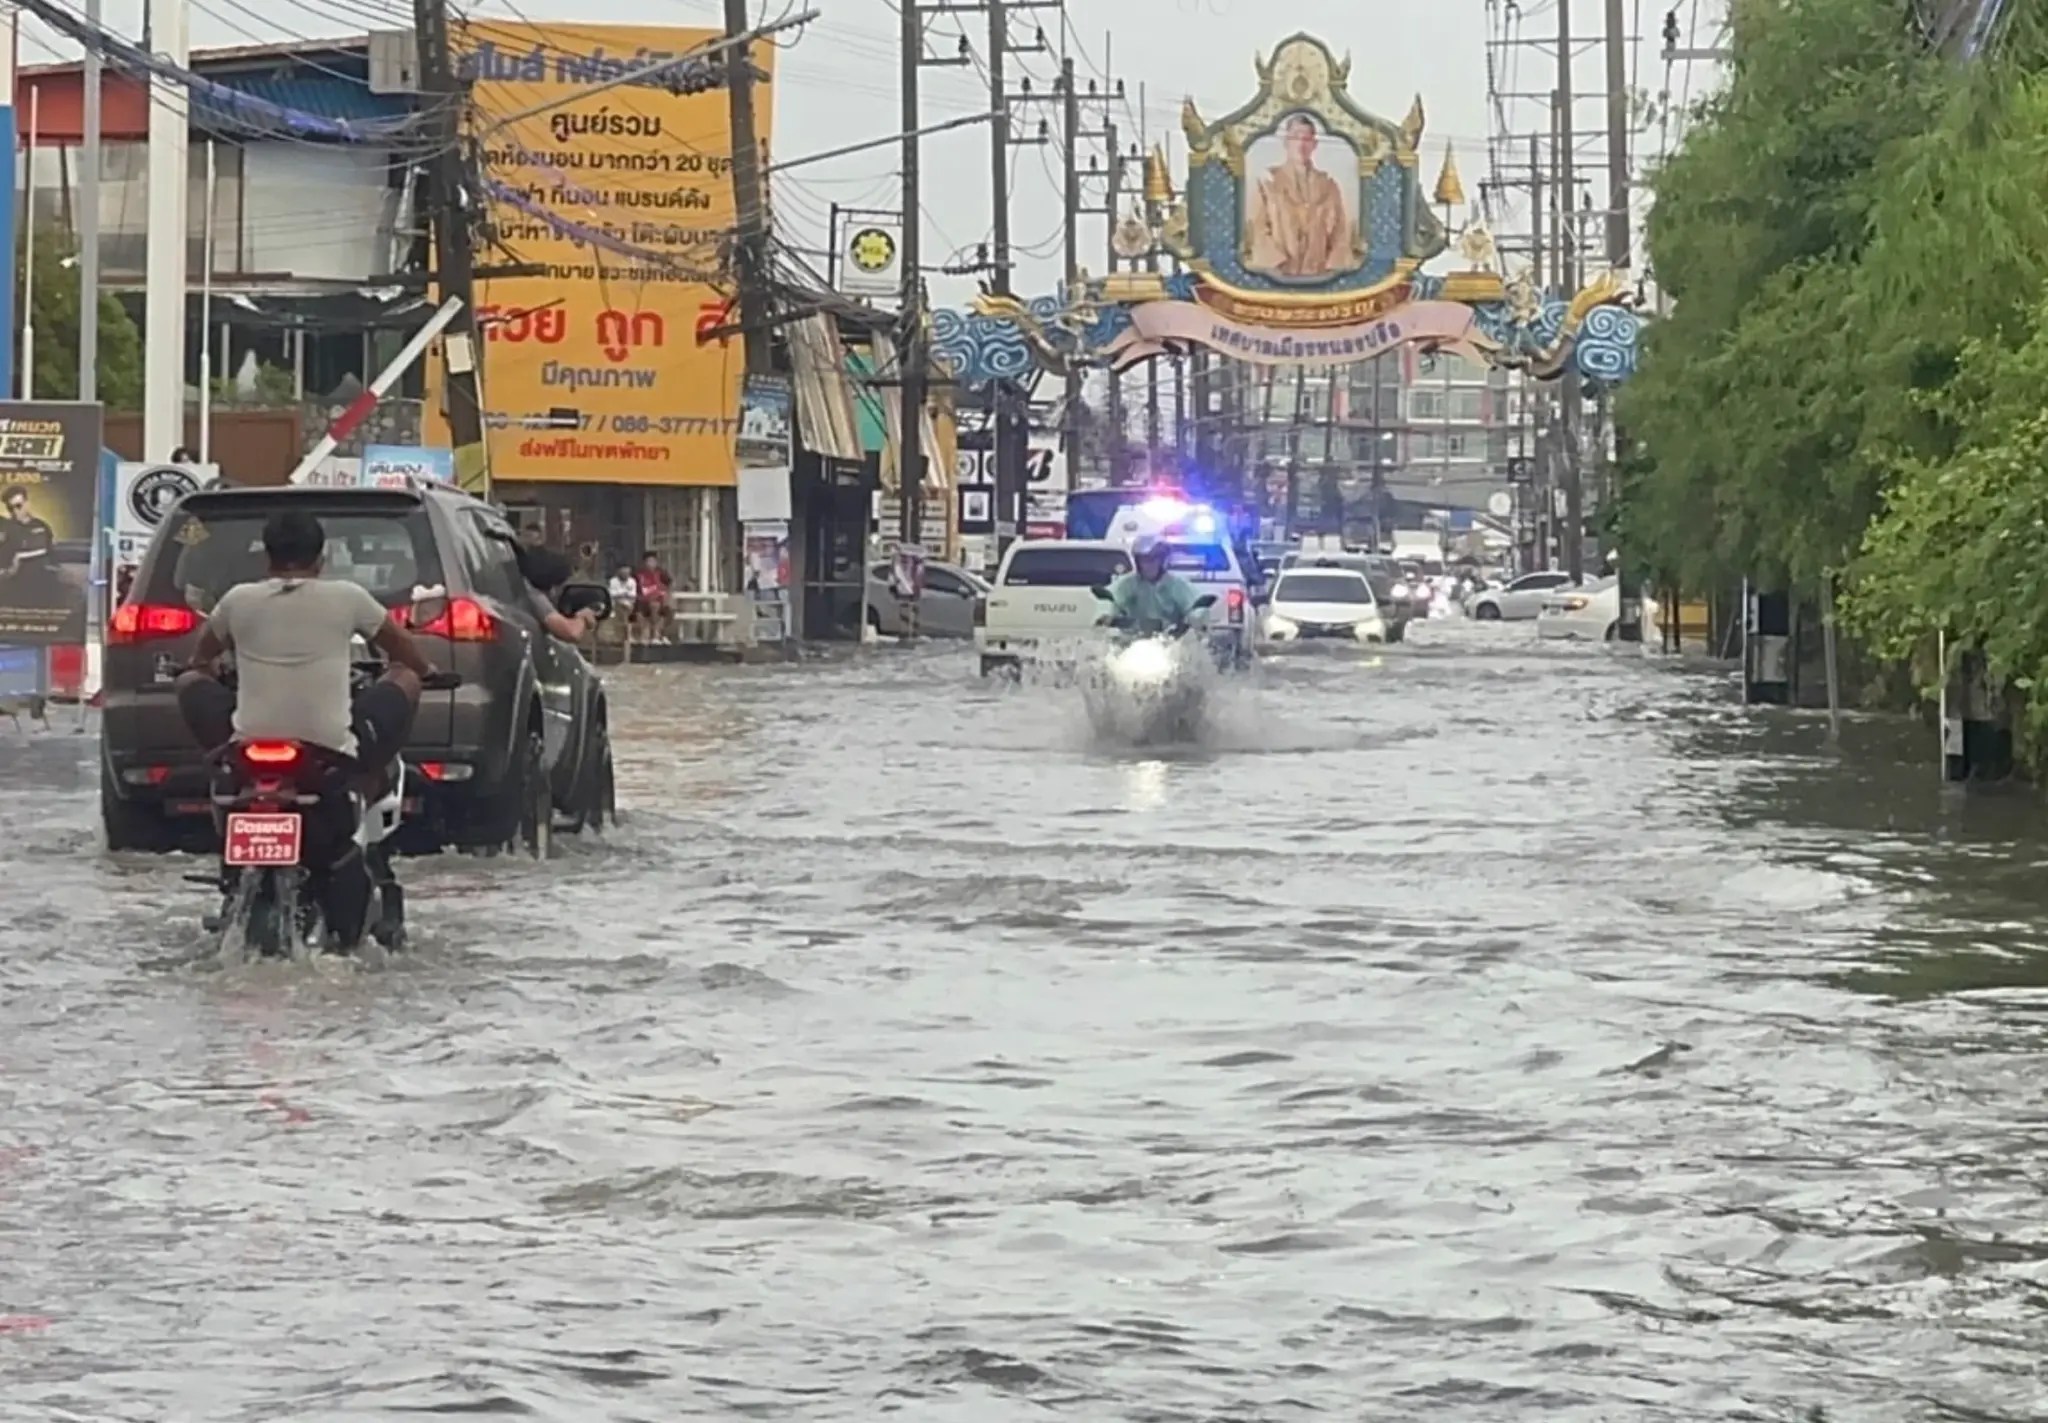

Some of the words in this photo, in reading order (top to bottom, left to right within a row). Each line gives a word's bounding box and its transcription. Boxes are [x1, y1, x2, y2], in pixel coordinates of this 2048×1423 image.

[551, 106, 661, 142] ศูนย์รวม
[588, 148, 670, 172] มากกว่า
[675, 154, 701, 172] 20
[596, 309, 664, 363] ถูก
[541, 360, 656, 394] มีคุณภาพ
[1033, 603, 1077, 613] ISUZU
